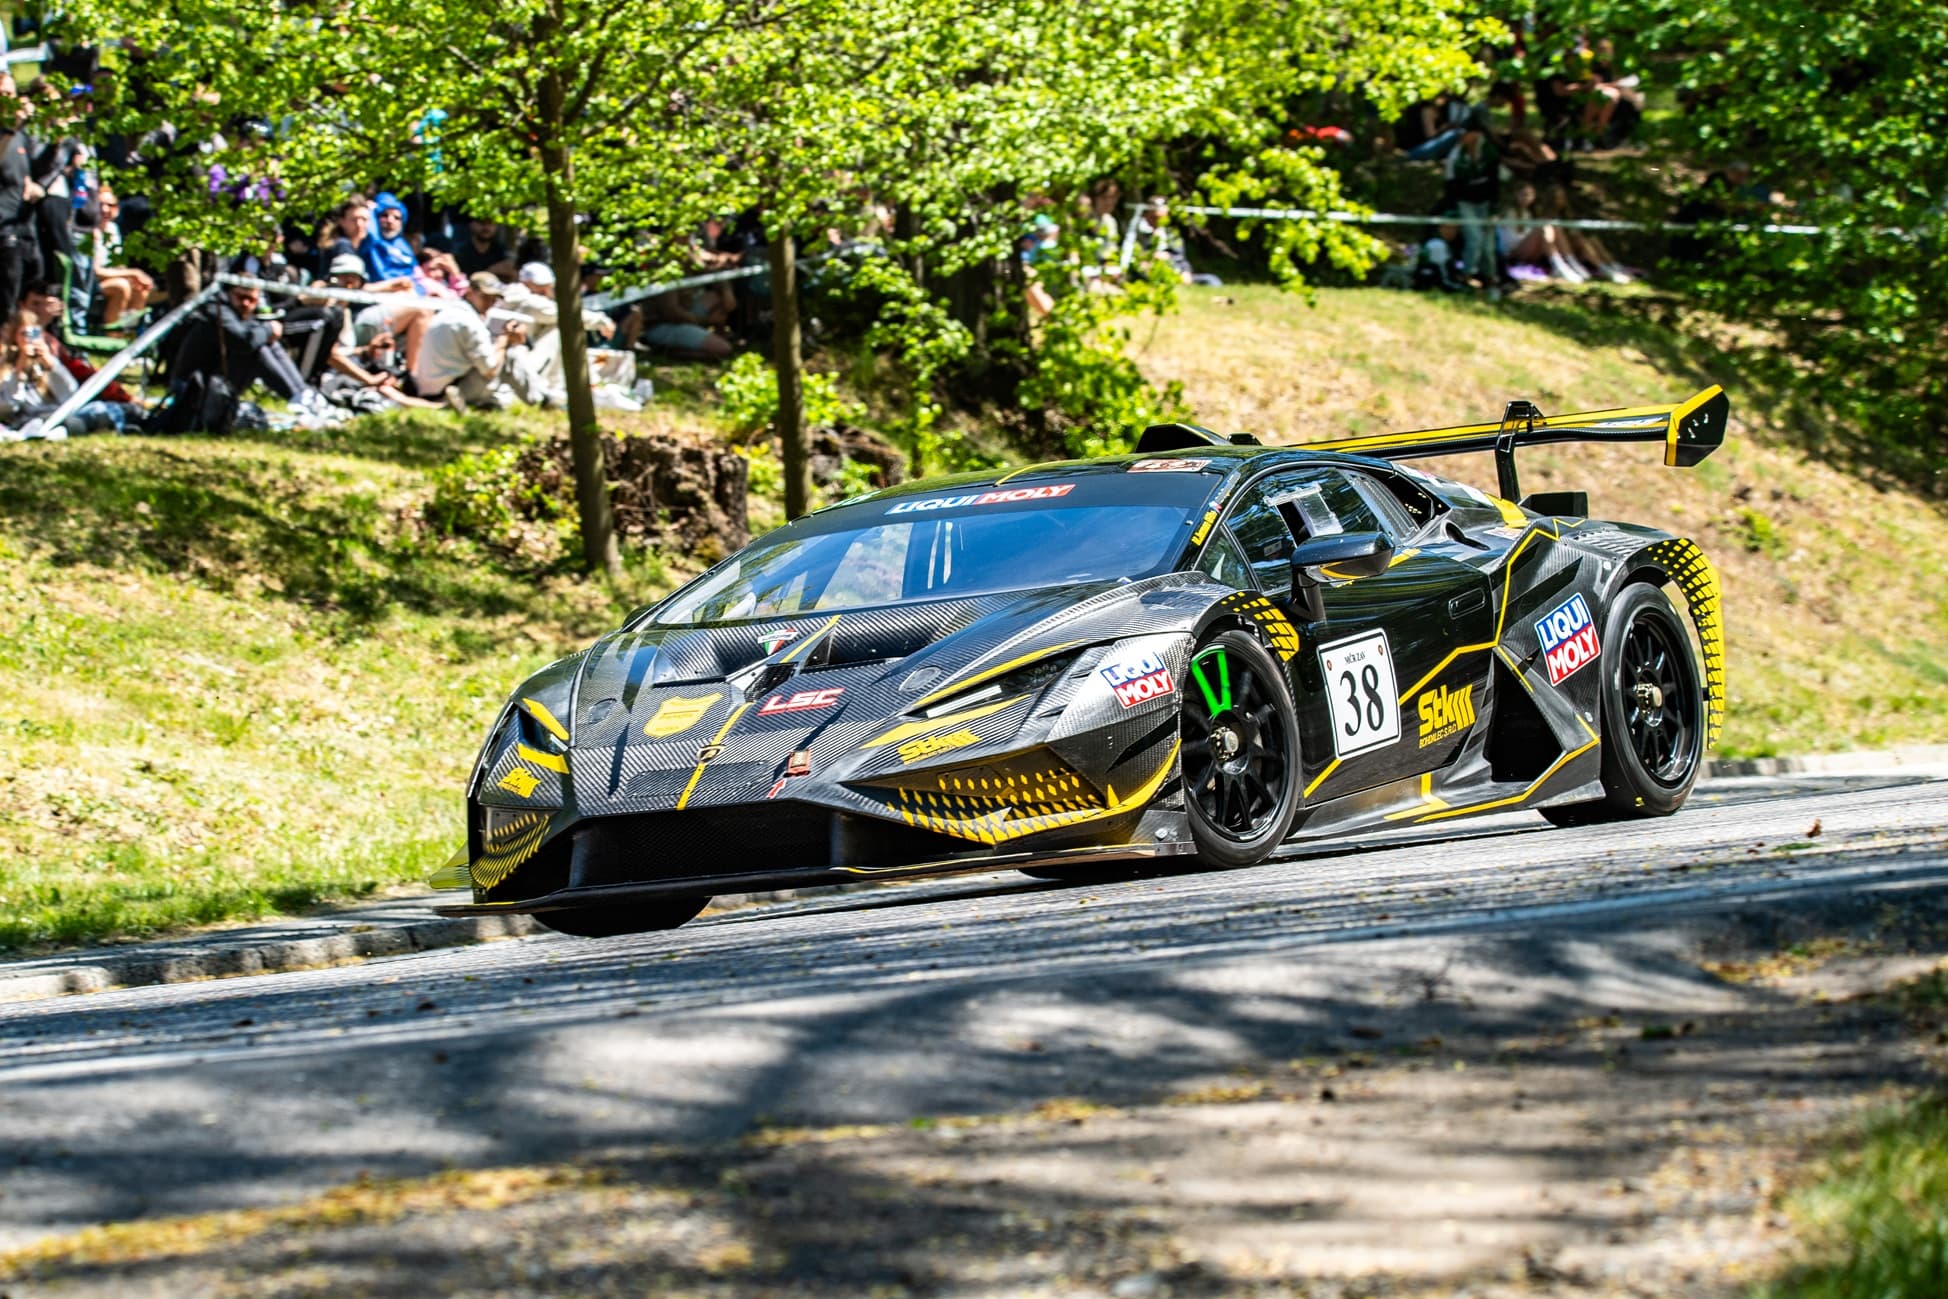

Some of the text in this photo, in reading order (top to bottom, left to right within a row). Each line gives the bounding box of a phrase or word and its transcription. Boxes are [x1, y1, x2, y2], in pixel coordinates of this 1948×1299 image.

[888, 484, 1074, 514] LIQUI MOLY
[1539, 597, 1589, 651] LIQUI
[1548, 626, 1596, 681] MOLY
[759, 688, 845, 716] LSC
[1115, 672, 1171, 706] MOLY
[1340, 664, 1385, 736] 38
